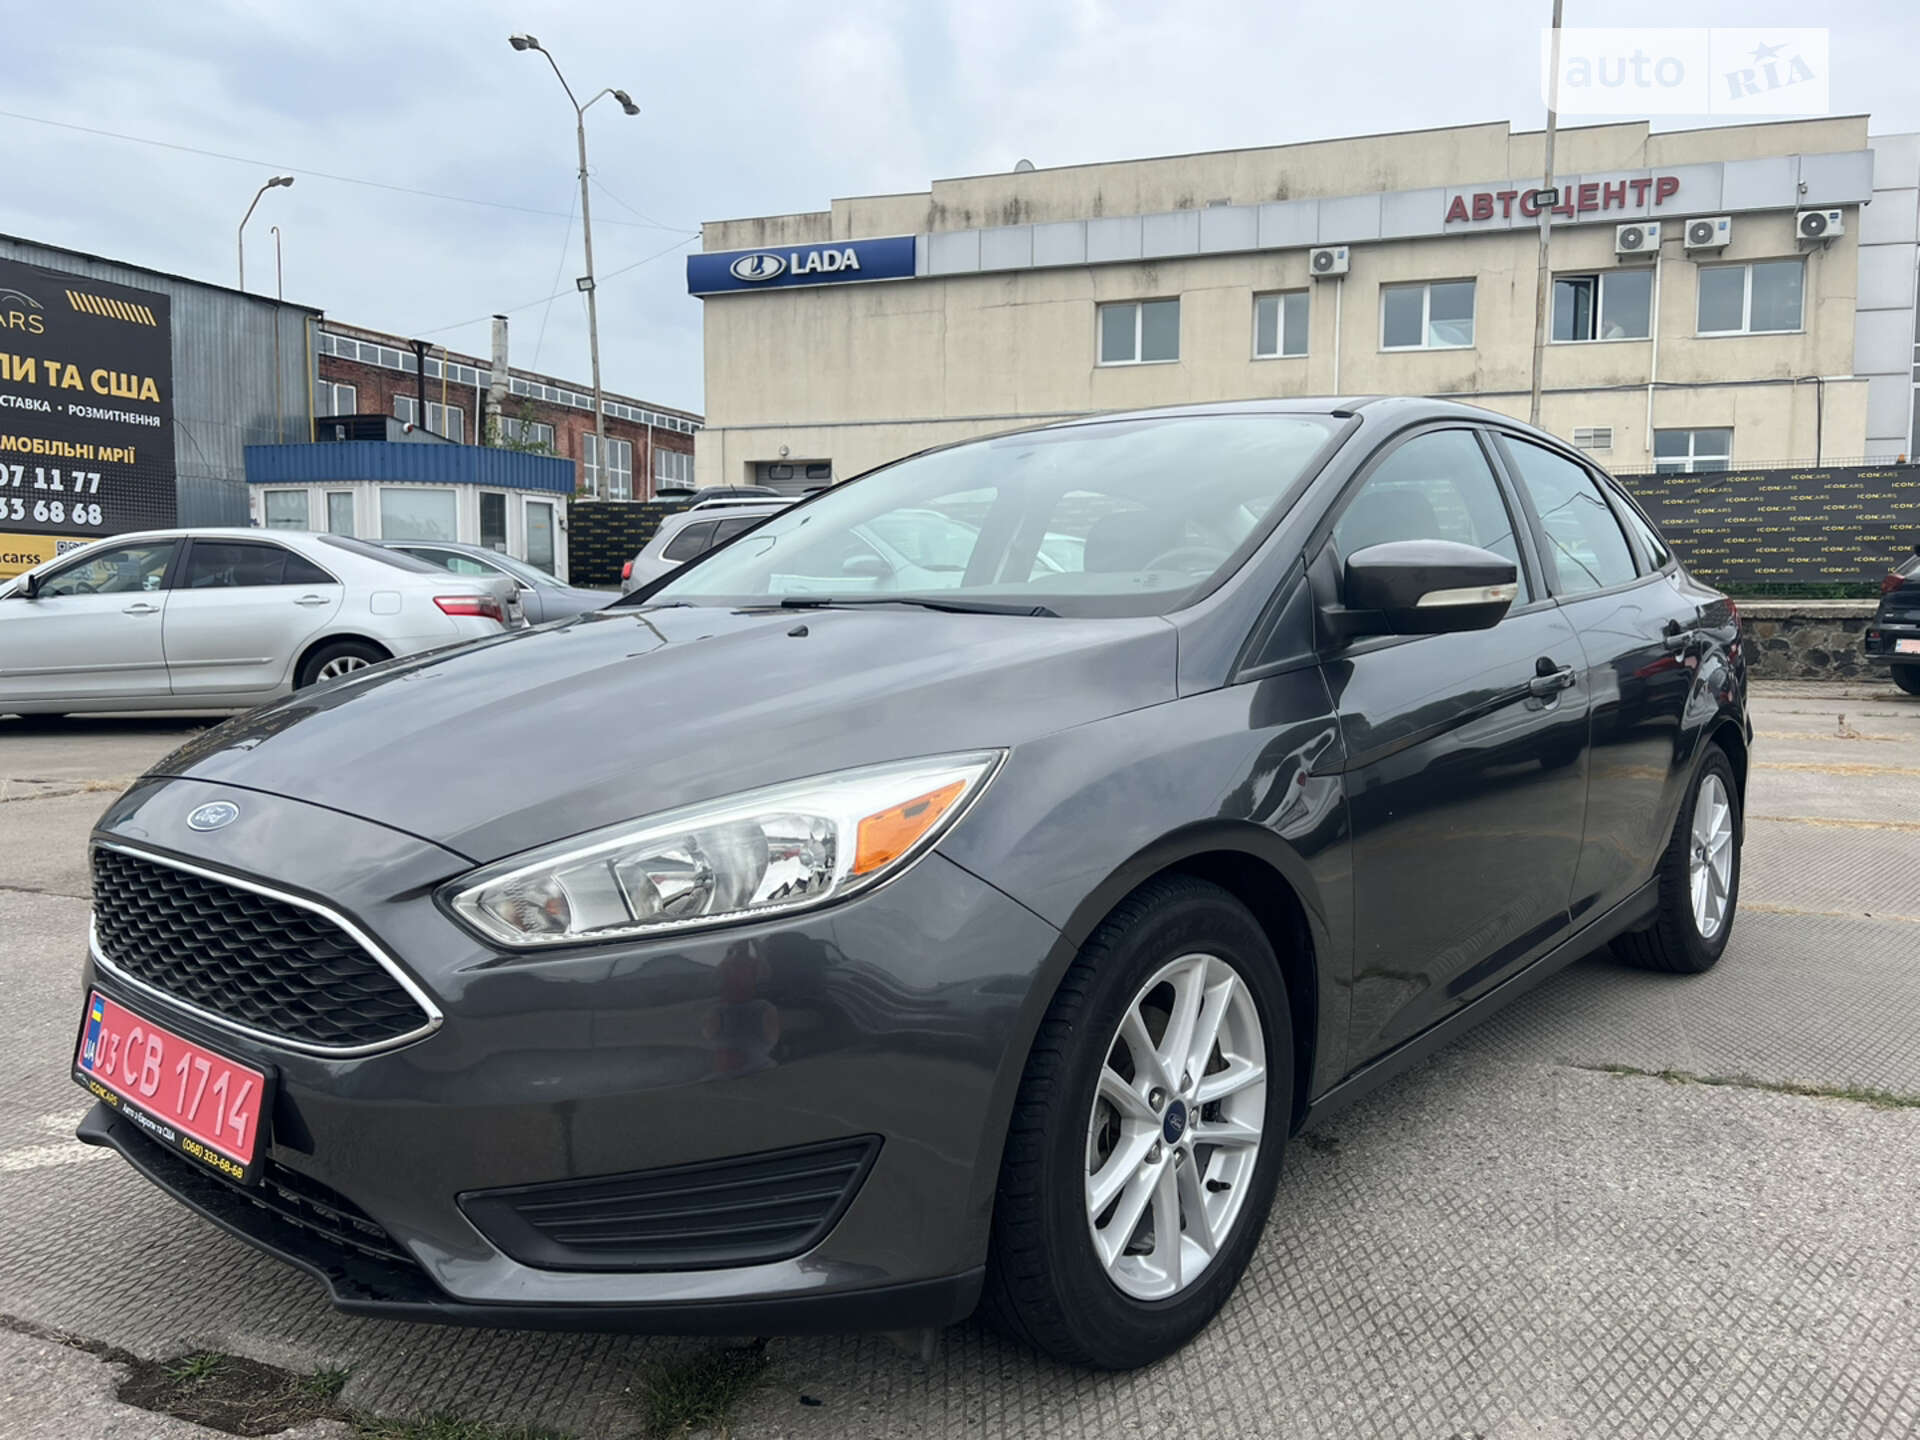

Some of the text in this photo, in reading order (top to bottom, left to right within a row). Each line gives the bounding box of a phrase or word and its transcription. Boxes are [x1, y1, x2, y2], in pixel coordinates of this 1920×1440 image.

[1445, 176, 1681, 223] АВТОЦЕНТР
[790, 248, 860, 275] LADA
[44, 360, 85, 391] ТА
[90, 368, 161, 403] США
[68, 404, 161, 428] РОЗМИТНЕННЯ
[0, 434, 136, 464] МОБІЛЬНІ МРІЇ
[34, 467, 64, 491] 11
[72, 471, 101, 494] 77
[33, 500, 65, 524] 68
[72, 503, 103, 526] 68
[0, 552, 41, 565] carss
[84, 1038, 96, 1061] UA
[176, 1052, 253, 1148] 1714
